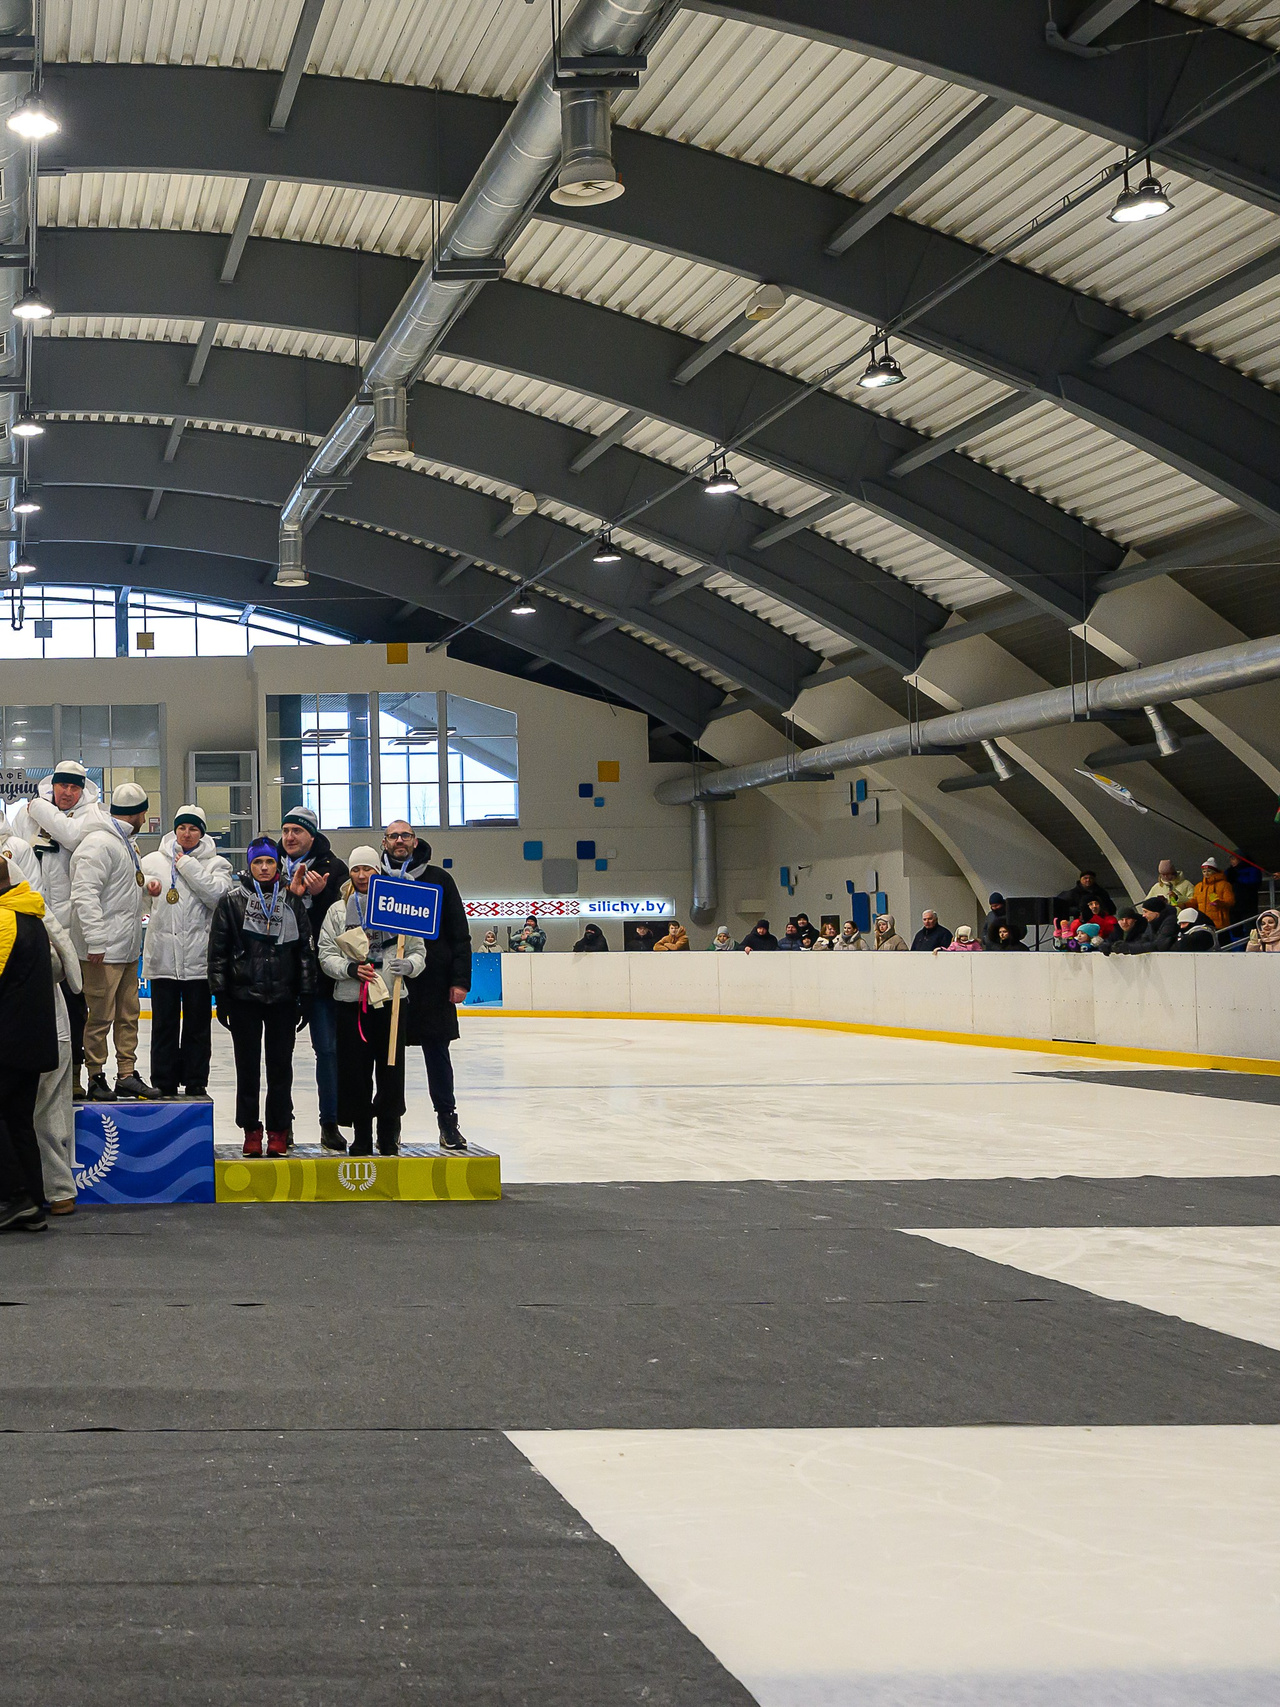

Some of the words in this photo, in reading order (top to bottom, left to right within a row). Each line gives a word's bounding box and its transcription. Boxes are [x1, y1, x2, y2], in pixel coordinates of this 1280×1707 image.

[378, 895, 430, 918] Единые
[588, 900, 666, 914] silichy.by
[344, 1162, 371, 1180] III
